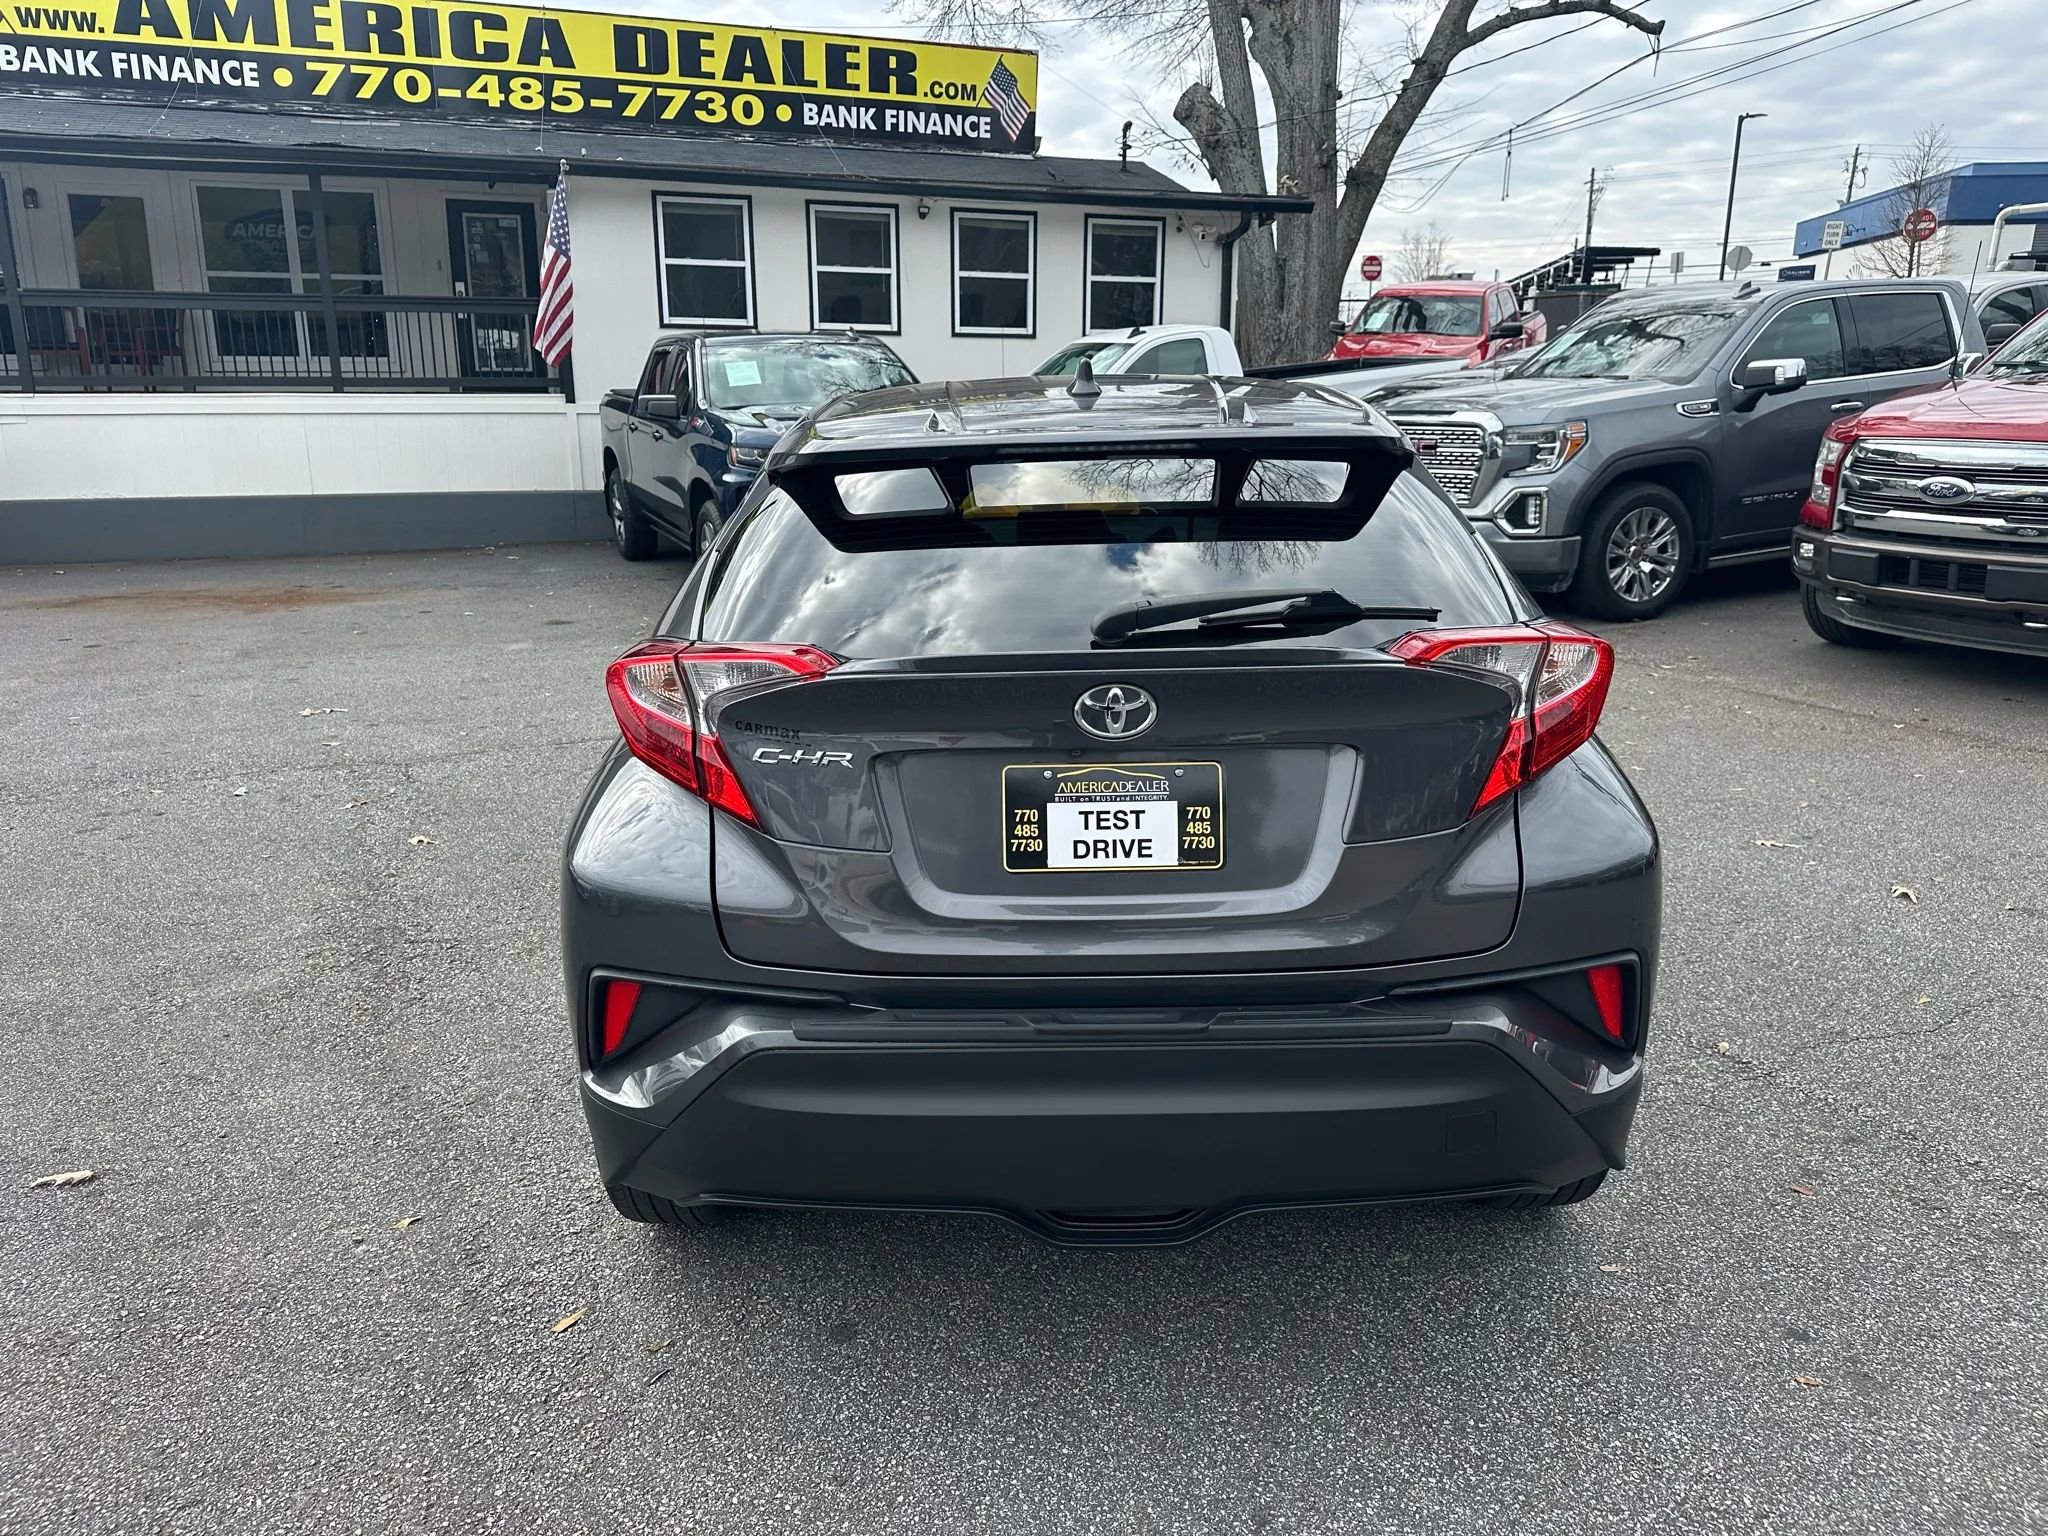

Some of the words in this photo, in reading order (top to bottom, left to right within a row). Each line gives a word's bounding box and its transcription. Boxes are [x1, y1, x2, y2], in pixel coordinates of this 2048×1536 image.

[113, 0, 577, 69] AMERICA
[613, 24, 917, 96] DEALER
[923, 80, 977, 101] .COM
[0, 44, 103, 77] BANK
[111, 52, 260, 87] FINANCE
[305, 62, 765, 126] 770-485-7730
[803, 103, 877, 131] BANK
[885, 109, 991, 139] FINANCE
[1926, 482, 1957, 497] Ford
[753, 748, 854, 769] C-HR
[1014, 809, 1039, 822] 770
[1186, 806, 1211, 819] 770
[1078, 809, 1146, 831] TEST
[1014, 824, 1039, 837] 485
[1186, 821, 1211, 834] 485
[1010, 839, 1043, 852] 7730
[1073, 838, 1153, 859] DRIVE
[1182, 836, 1215, 849] 7730
